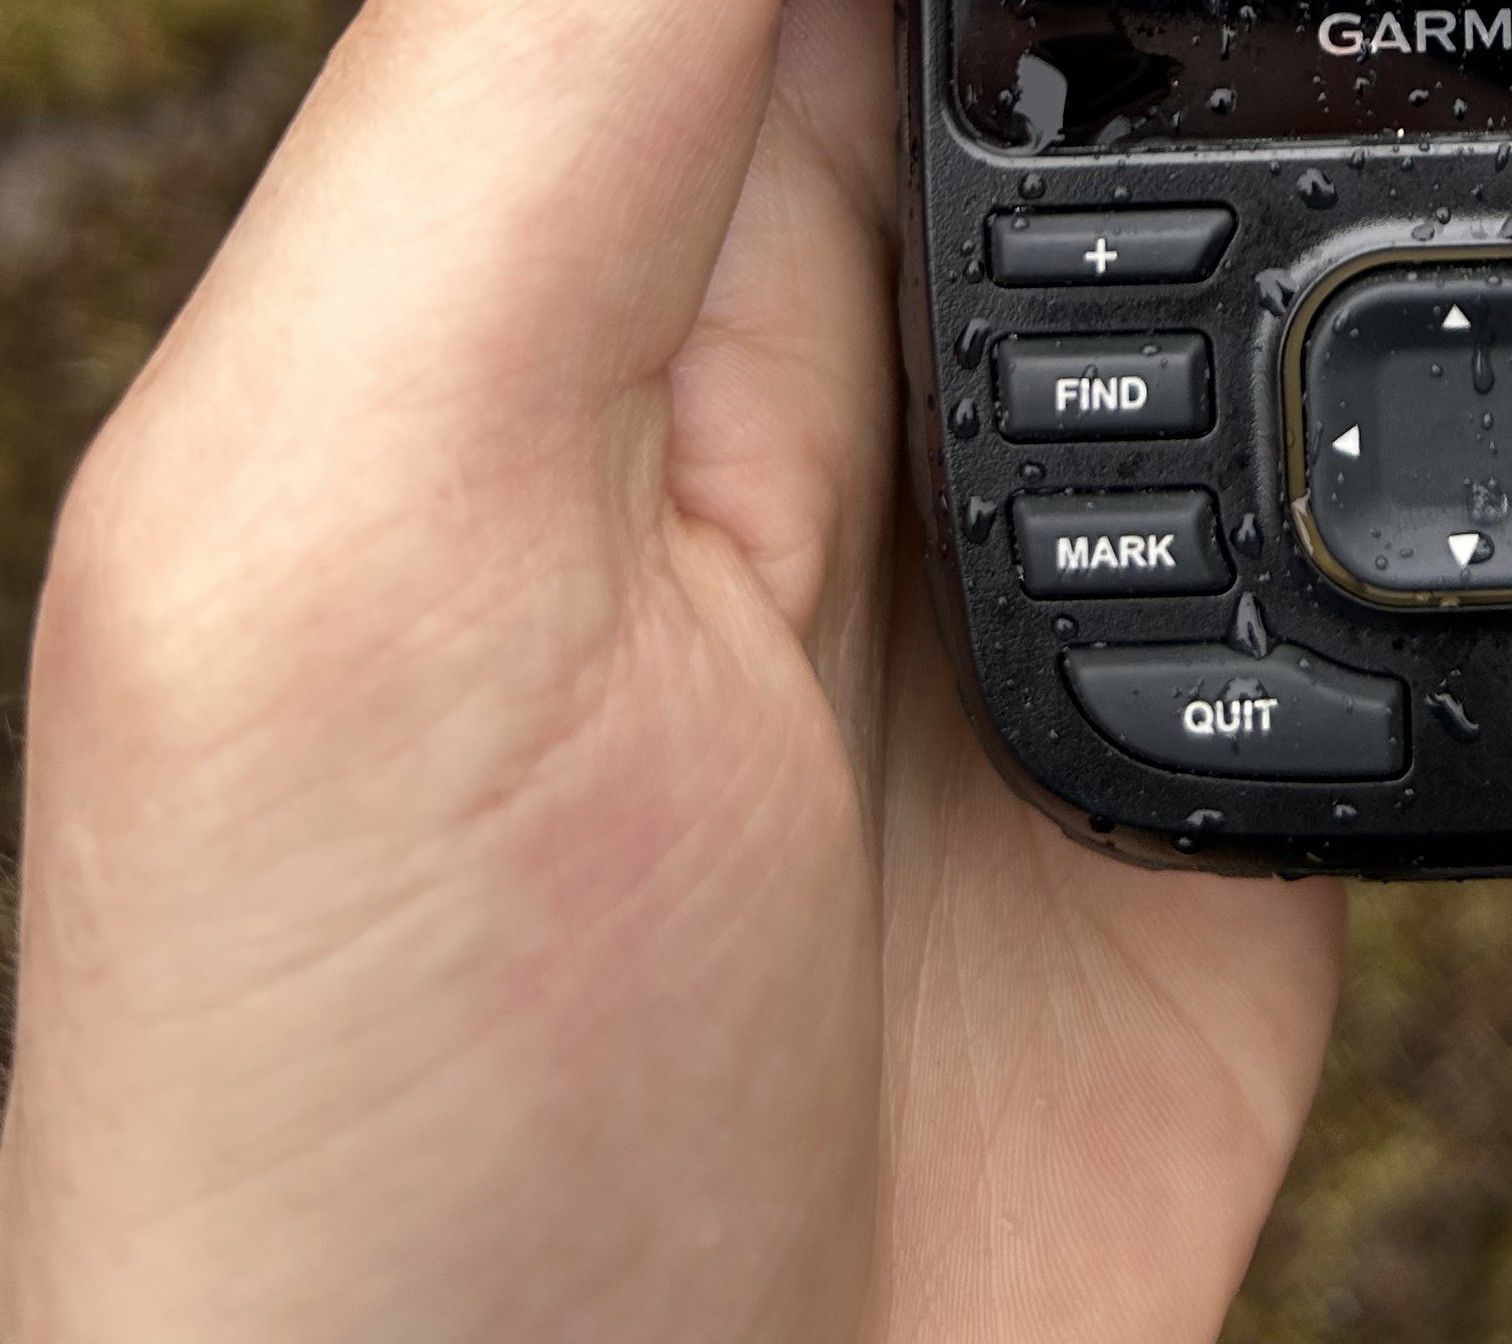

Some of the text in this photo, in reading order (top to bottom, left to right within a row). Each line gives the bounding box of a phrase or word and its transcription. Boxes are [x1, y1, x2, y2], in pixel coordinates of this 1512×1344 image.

[1056, 376, 1147, 411] FIND
[1056, 534, 1175, 571] MARK
[1183, 698, 1278, 736] QUIT
